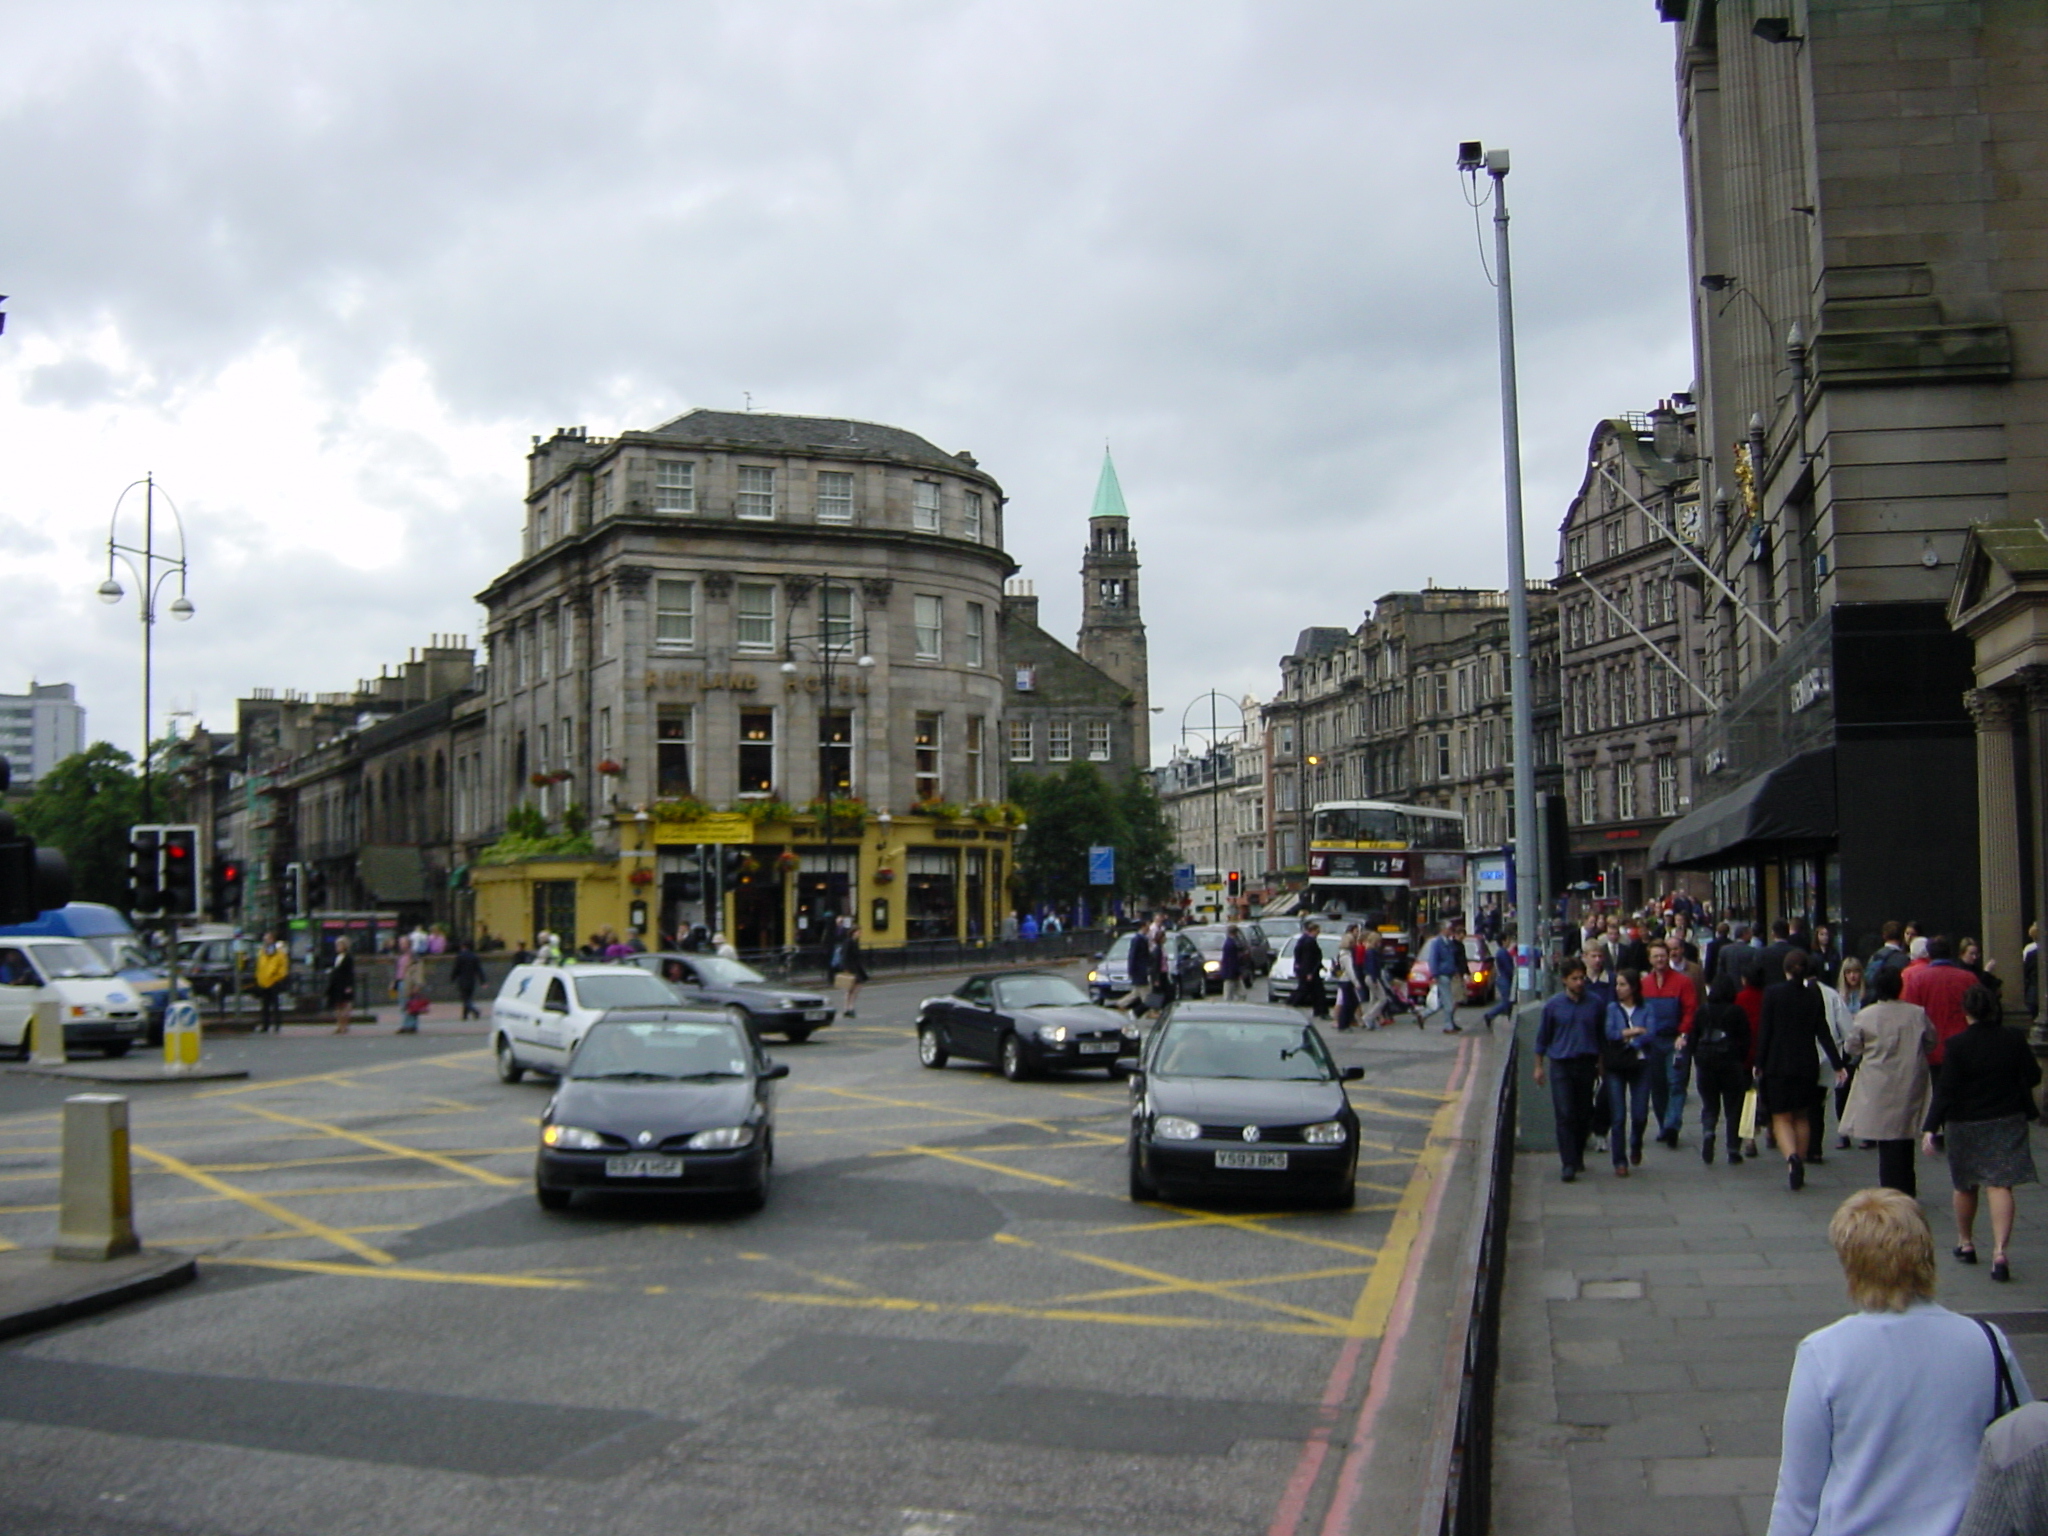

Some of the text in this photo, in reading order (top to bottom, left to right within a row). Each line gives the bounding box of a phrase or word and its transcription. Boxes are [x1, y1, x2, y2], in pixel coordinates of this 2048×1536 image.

[645, 669, 871, 694] RUTLAND HOEL
[1373, 860, 1388, 873] 12
